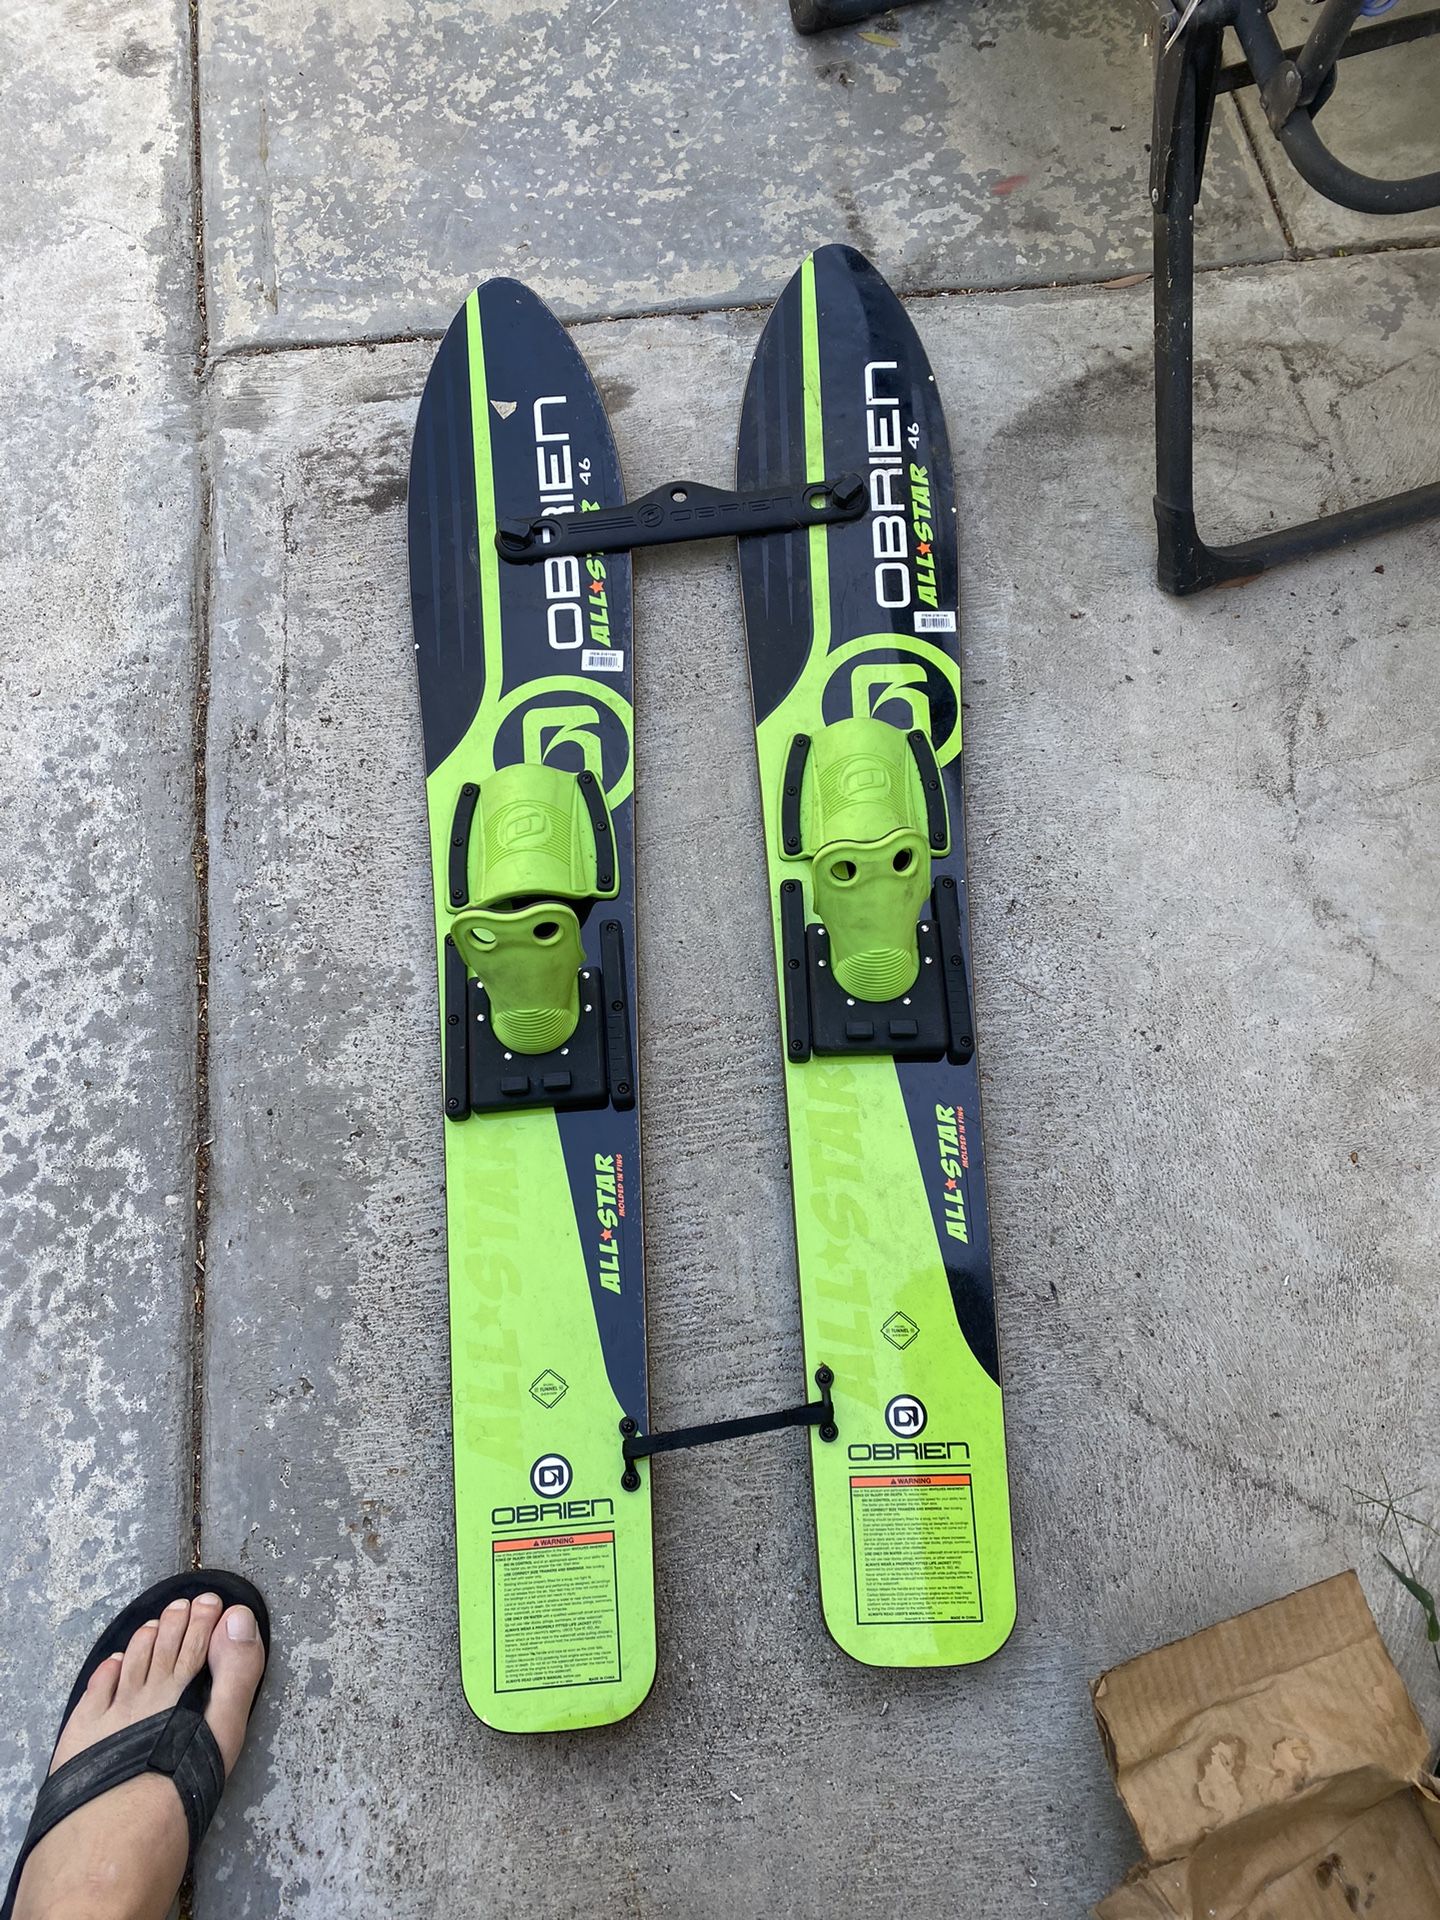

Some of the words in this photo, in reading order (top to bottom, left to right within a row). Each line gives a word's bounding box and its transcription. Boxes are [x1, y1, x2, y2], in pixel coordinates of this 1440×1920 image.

[907, 422, 920, 450] 46
[578, 457, 592, 485] 46
[864, 361, 911, 609] OBRIEN
[533, 395, 584, 650] OBIEN
[909, 462, 934, 543] STAR
[915, 553, 938, 609] ALL
[588, 591, 612, 648] ALL
[935, 1103, 962, 1179] STAR
[960, 1134, 969, 1168] MOLDED
[594, 1153, 619, 1229] STAR
[617, 1182, 626, 1217] MOLDED
[943, 1189, 969, 1244] ALL
[599, 1239, 622, 1295] ALL
[847, 1442, 970, 1462] OBRIEN
[491, 1498, 614, 1526] OBRIEN
[540, 1537, 575, 1546] WARNING
